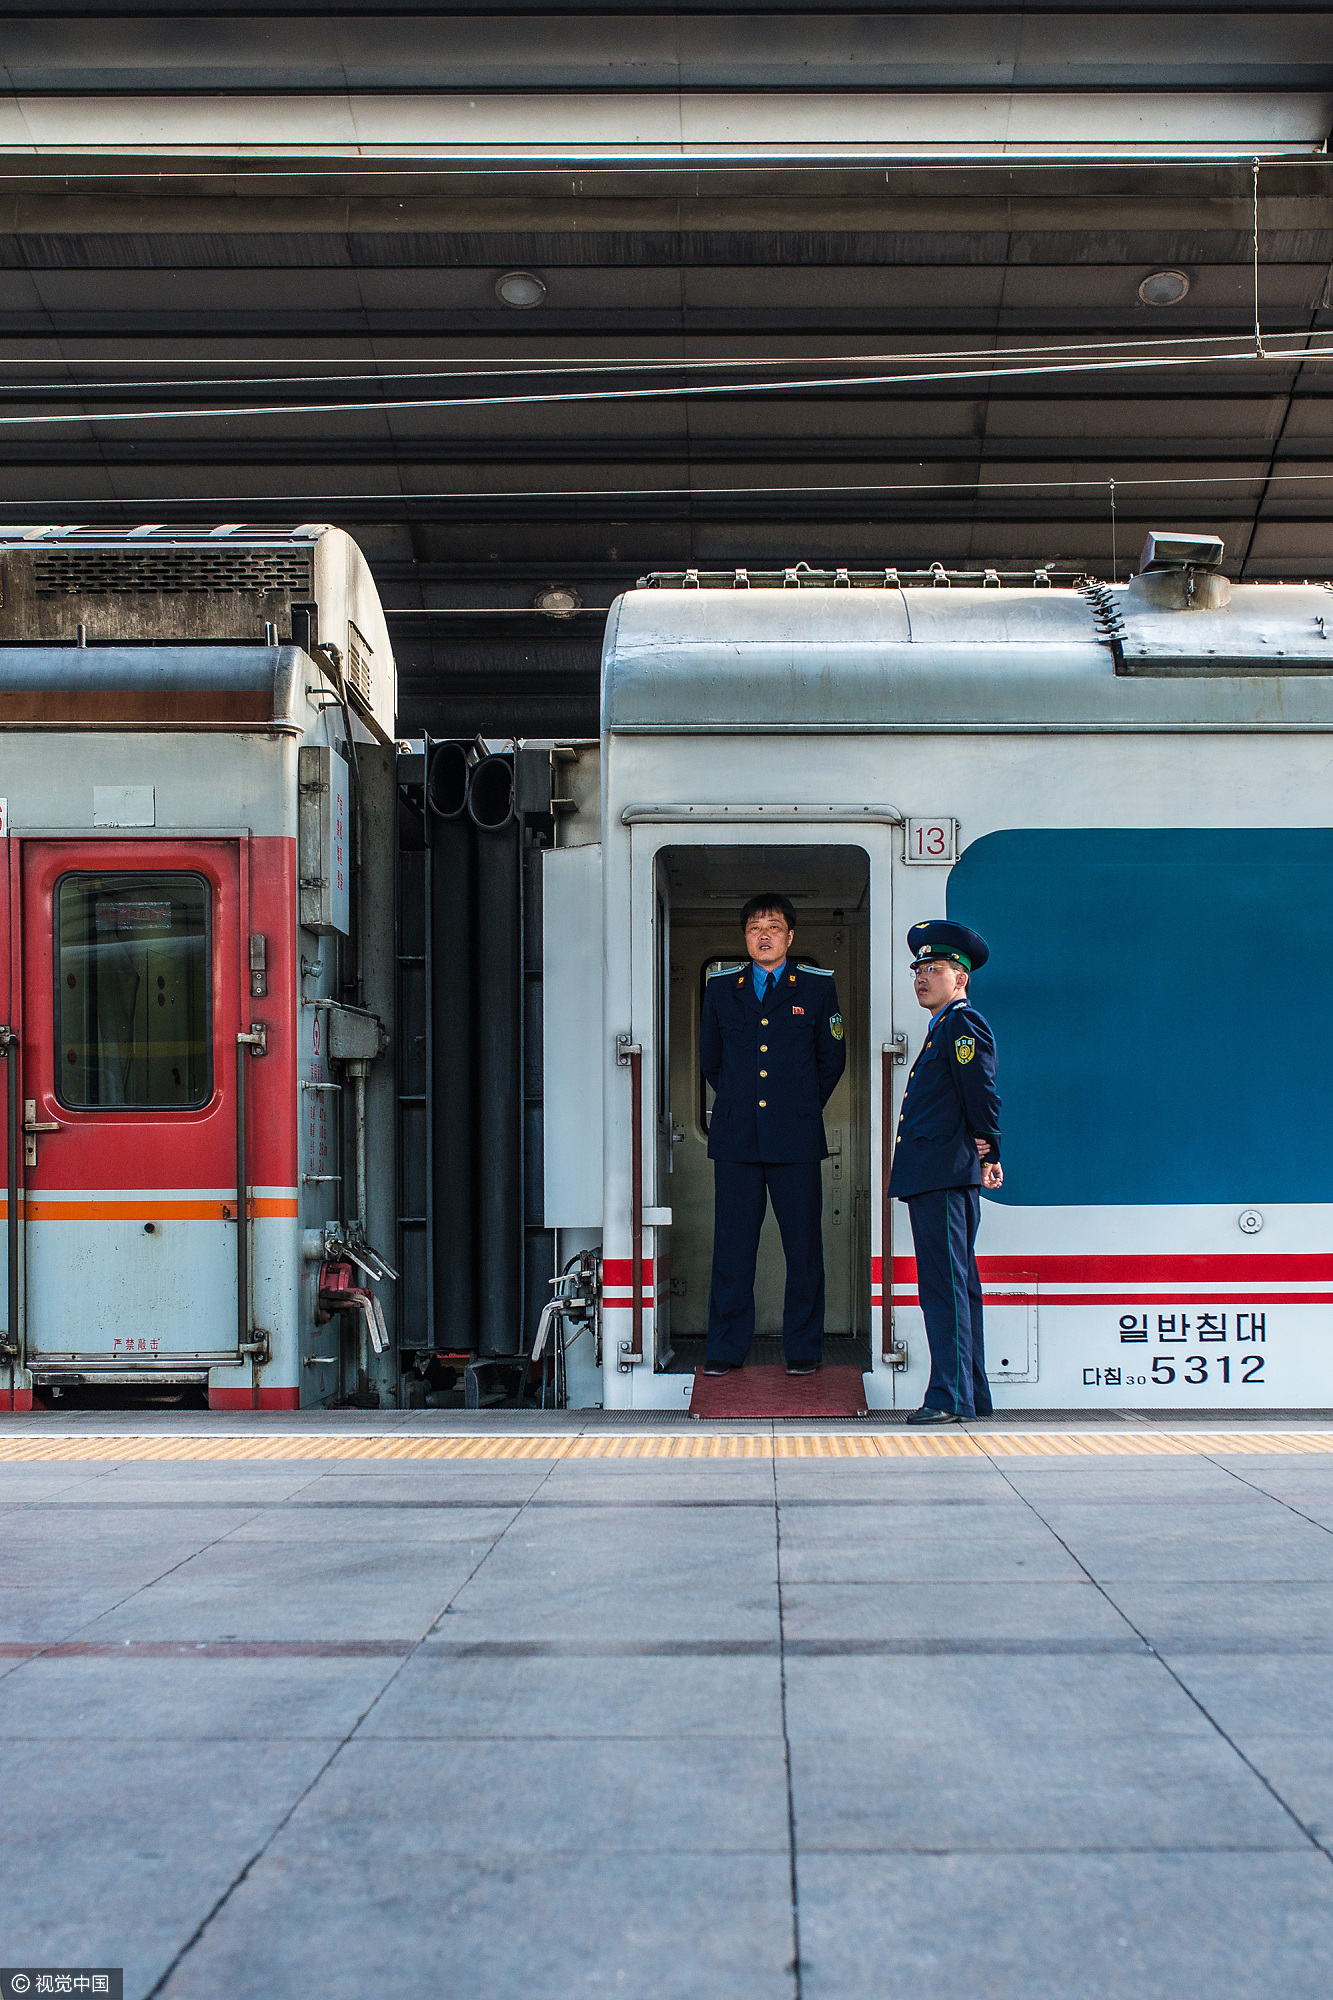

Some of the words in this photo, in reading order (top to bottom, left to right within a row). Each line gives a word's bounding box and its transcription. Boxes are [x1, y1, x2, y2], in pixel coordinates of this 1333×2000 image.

[915, 827, 945, 855] 13
[1119, 1313, 1266, 1343] 일반침대
[113, 1338, 158, 1350] 严禁敲击
[1150, 1355, 1265, 1385] 5312
